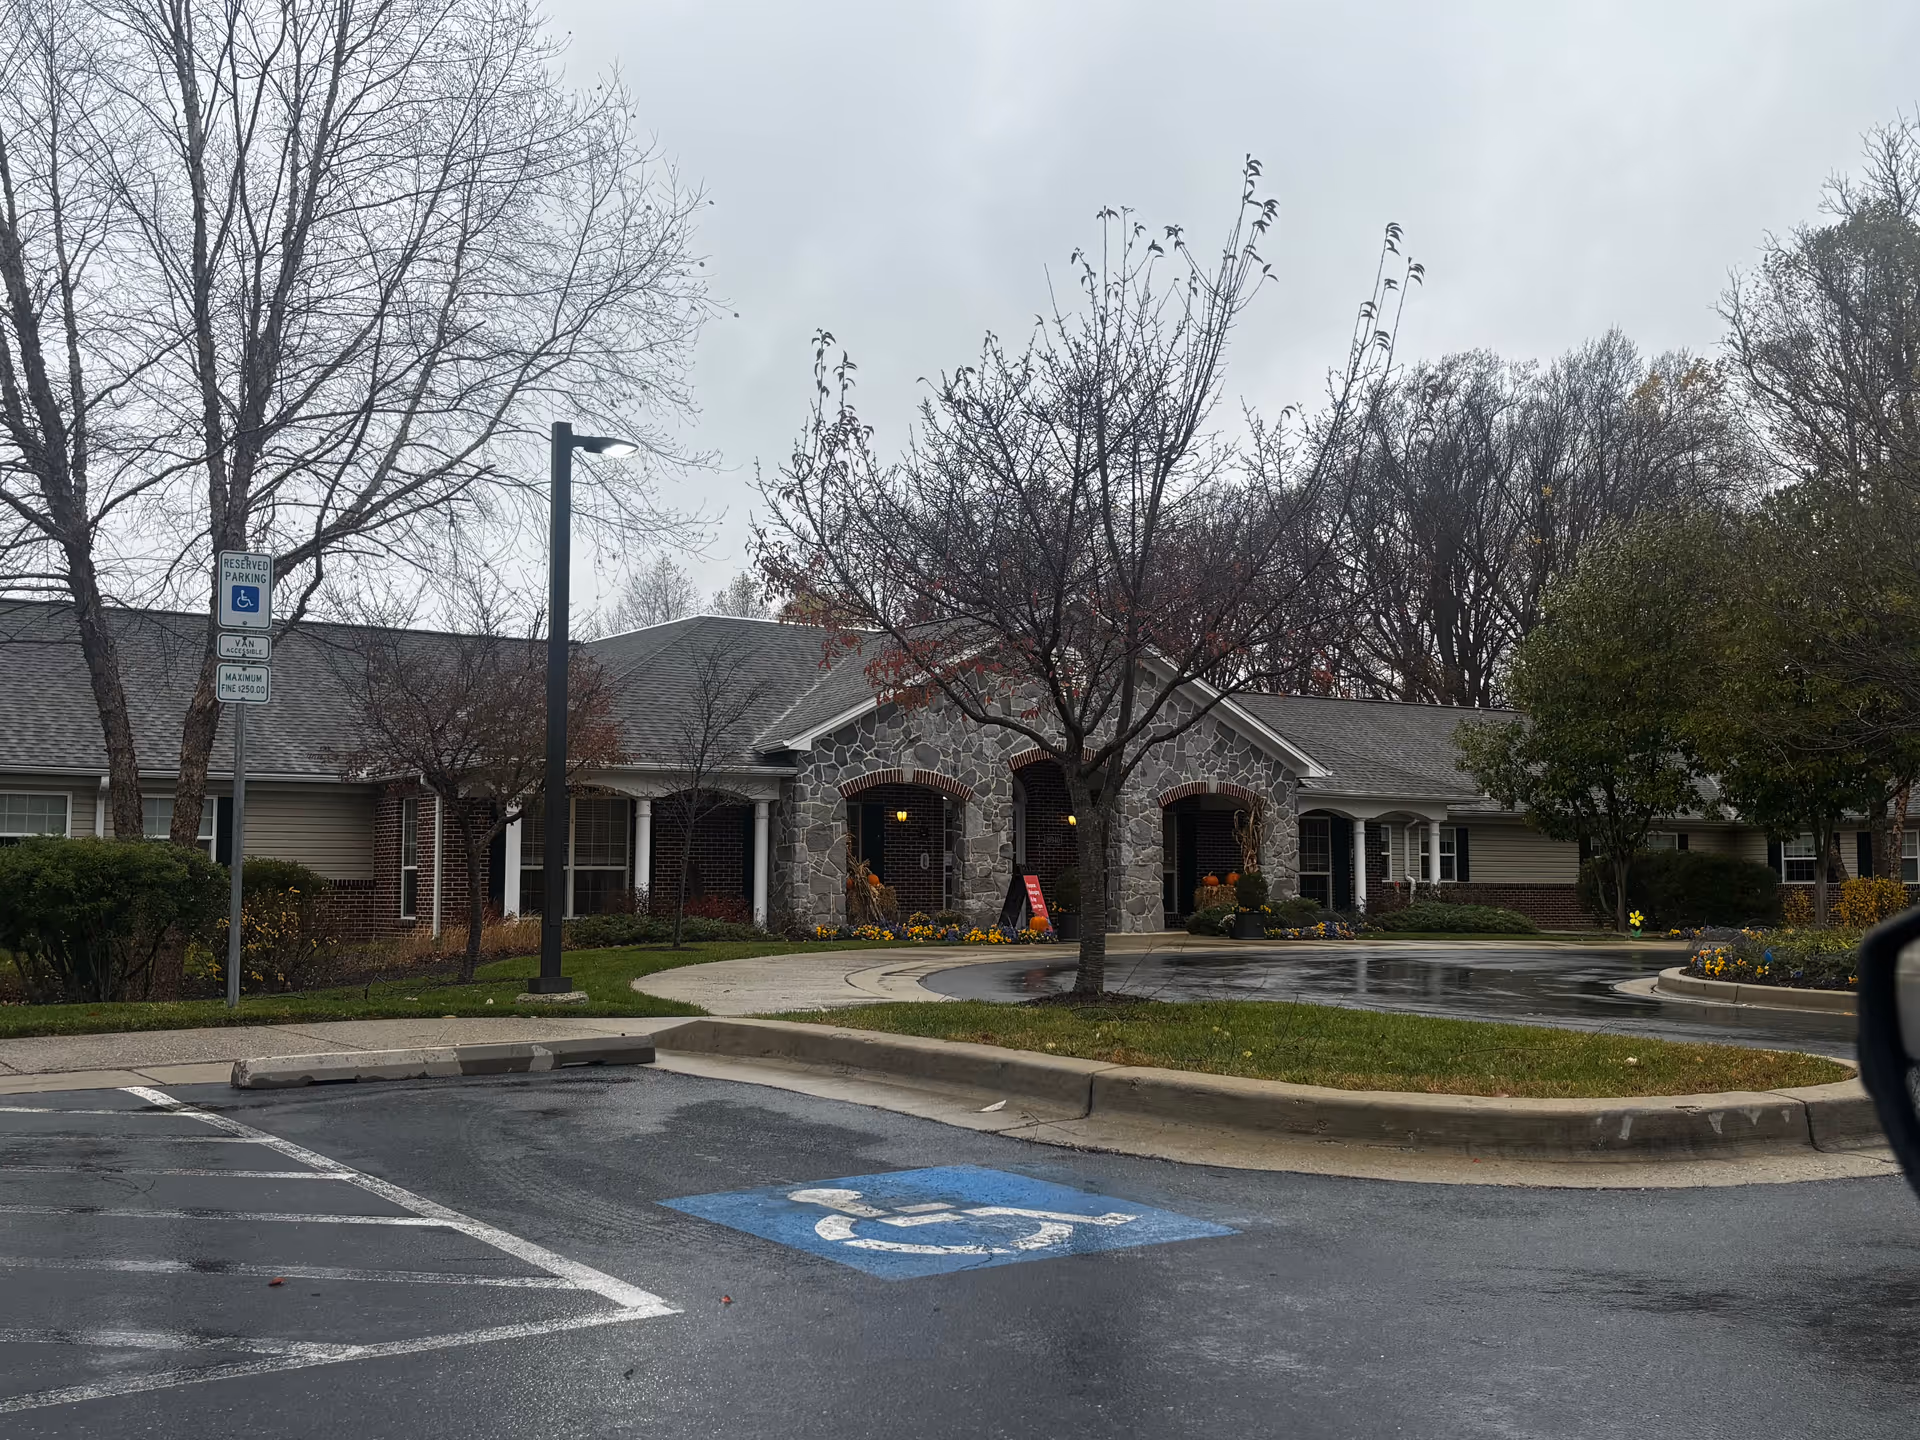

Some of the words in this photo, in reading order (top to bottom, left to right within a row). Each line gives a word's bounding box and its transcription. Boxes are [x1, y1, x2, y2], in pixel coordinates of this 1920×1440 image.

[224, 558, 268, 571] RESERVED
[225, 571, 267, 584] PARKING
[235, 640, 255, 648] VAN
[226, 647, 263, 655] ACCESSIBLE
[225, 673, 262, 682] MAXIMUM
[221, 684, 236, 692] FINE
[238, 685, 265, 694] $250.00
